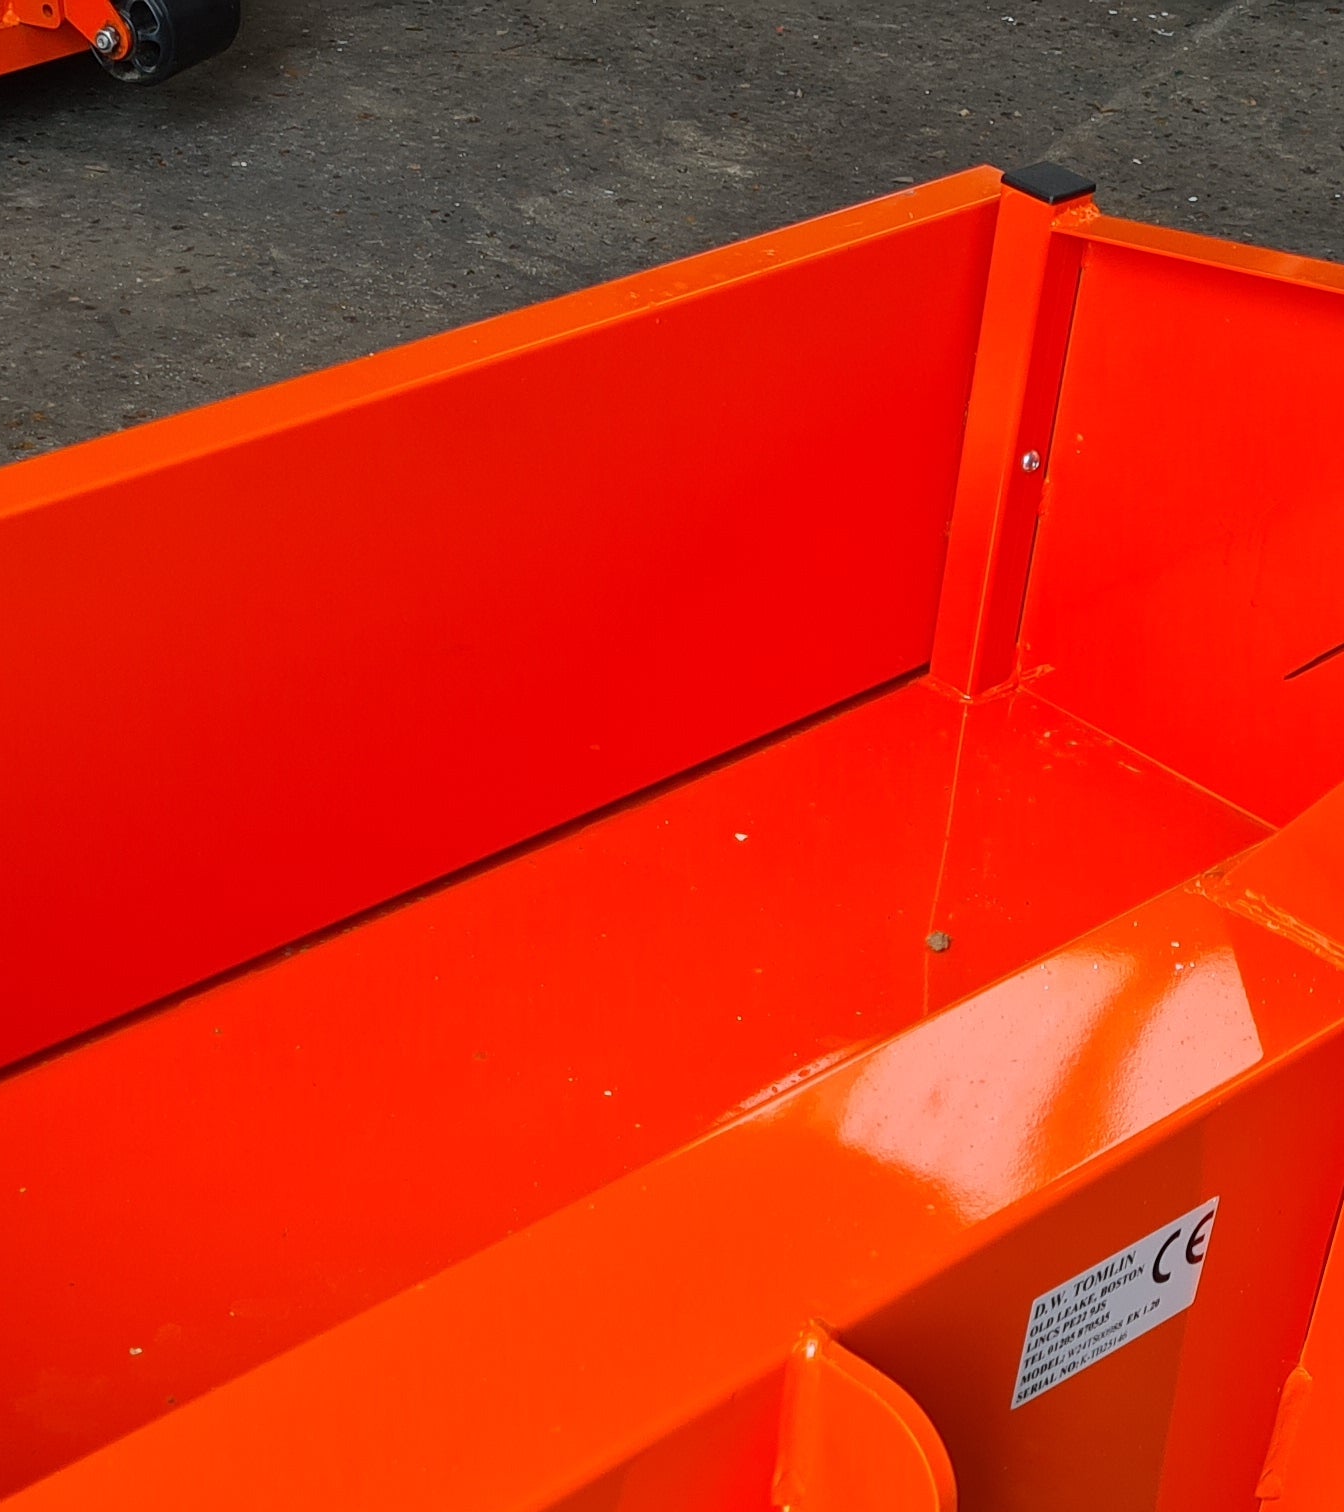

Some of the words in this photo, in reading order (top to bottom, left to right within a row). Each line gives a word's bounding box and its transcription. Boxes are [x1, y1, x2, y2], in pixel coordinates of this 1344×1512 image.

[1029, 1316, 1054, 1338] OLD
[1056, 1293, 1098, 1322] LEAKE,
[1100, 1264, 1146, 1298] BOSTON
[1033, 1290, 1068, 1321] D.W.
[1073, 1250, 1137, 1298] TOMLIN
[1026, 1327, 1061, 1354] LINCS
[1062, 1311, 1088, 1334] PE22
[1126, 1311, 1141, 1326] EK
[1023, 1350, 1046, 1370] TEL
[1047, 1334, 1076, 1354] 01205
[1015, 1373, 1057, 1404] SERIAL
